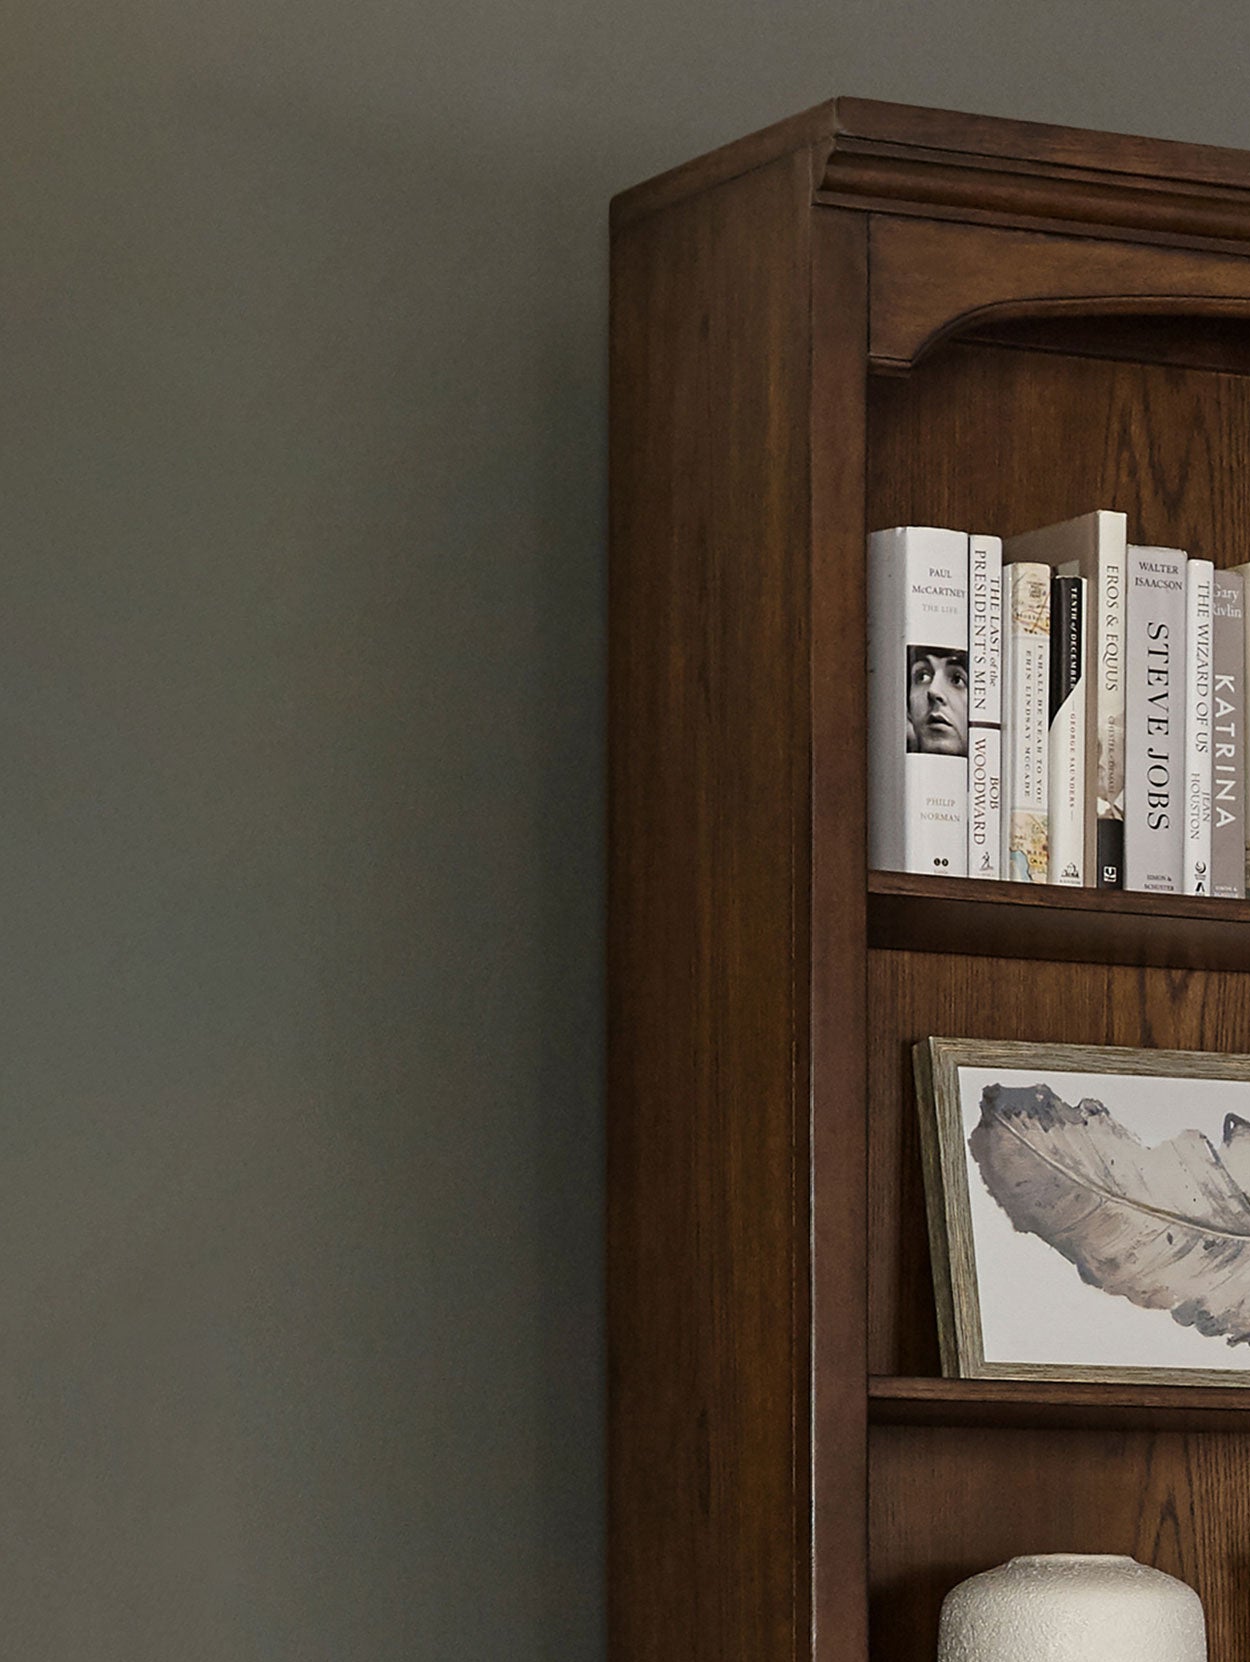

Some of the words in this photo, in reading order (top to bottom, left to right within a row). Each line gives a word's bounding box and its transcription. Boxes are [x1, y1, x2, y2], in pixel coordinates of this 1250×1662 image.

[929, 568, 953, 579] PAUL
[1135, 577, 1184, 590] ISAACSON
[1138, 561, 1180, 575] WALTER
[912, 585, 966, 599] McCARTNEY
[990, 576, 1000, 611] THE
[1105, 565, 1119, 610] EROS
[1197, 580, 1210, 618] THE
[974, 549, 987, 664] PRESIDENT'S
[1106, 615, 1118, 628] &
[990, 623, 1000, 656] LAST
[989, 657, 998, 671] of
[1103, 633, 1118, 691] EQUUS
[1196, 623, 1210, 697] WIZARD
[974, 671, 987, 711] MEN
[989, 672, 998, 688] the
[1147, 621, 1170, 736] STEVE
[1196, 702, 1209, 726] OF
[1196, 732, 1208, 753] US
[1214, 673, 1237, 828] KATRINA
[926, 798, 956, 807] PHILIP
[974, 738, 987, 846] WOODWARD
[989, 777, 1000, 812] BOB
[1147, 747, 1170, 831] JOBS
[1190, 772, 1200, 840] HOUSTON
[920, 812, 961, 822] NORMAN
[1202, 791, 1211, 823] JEAN
